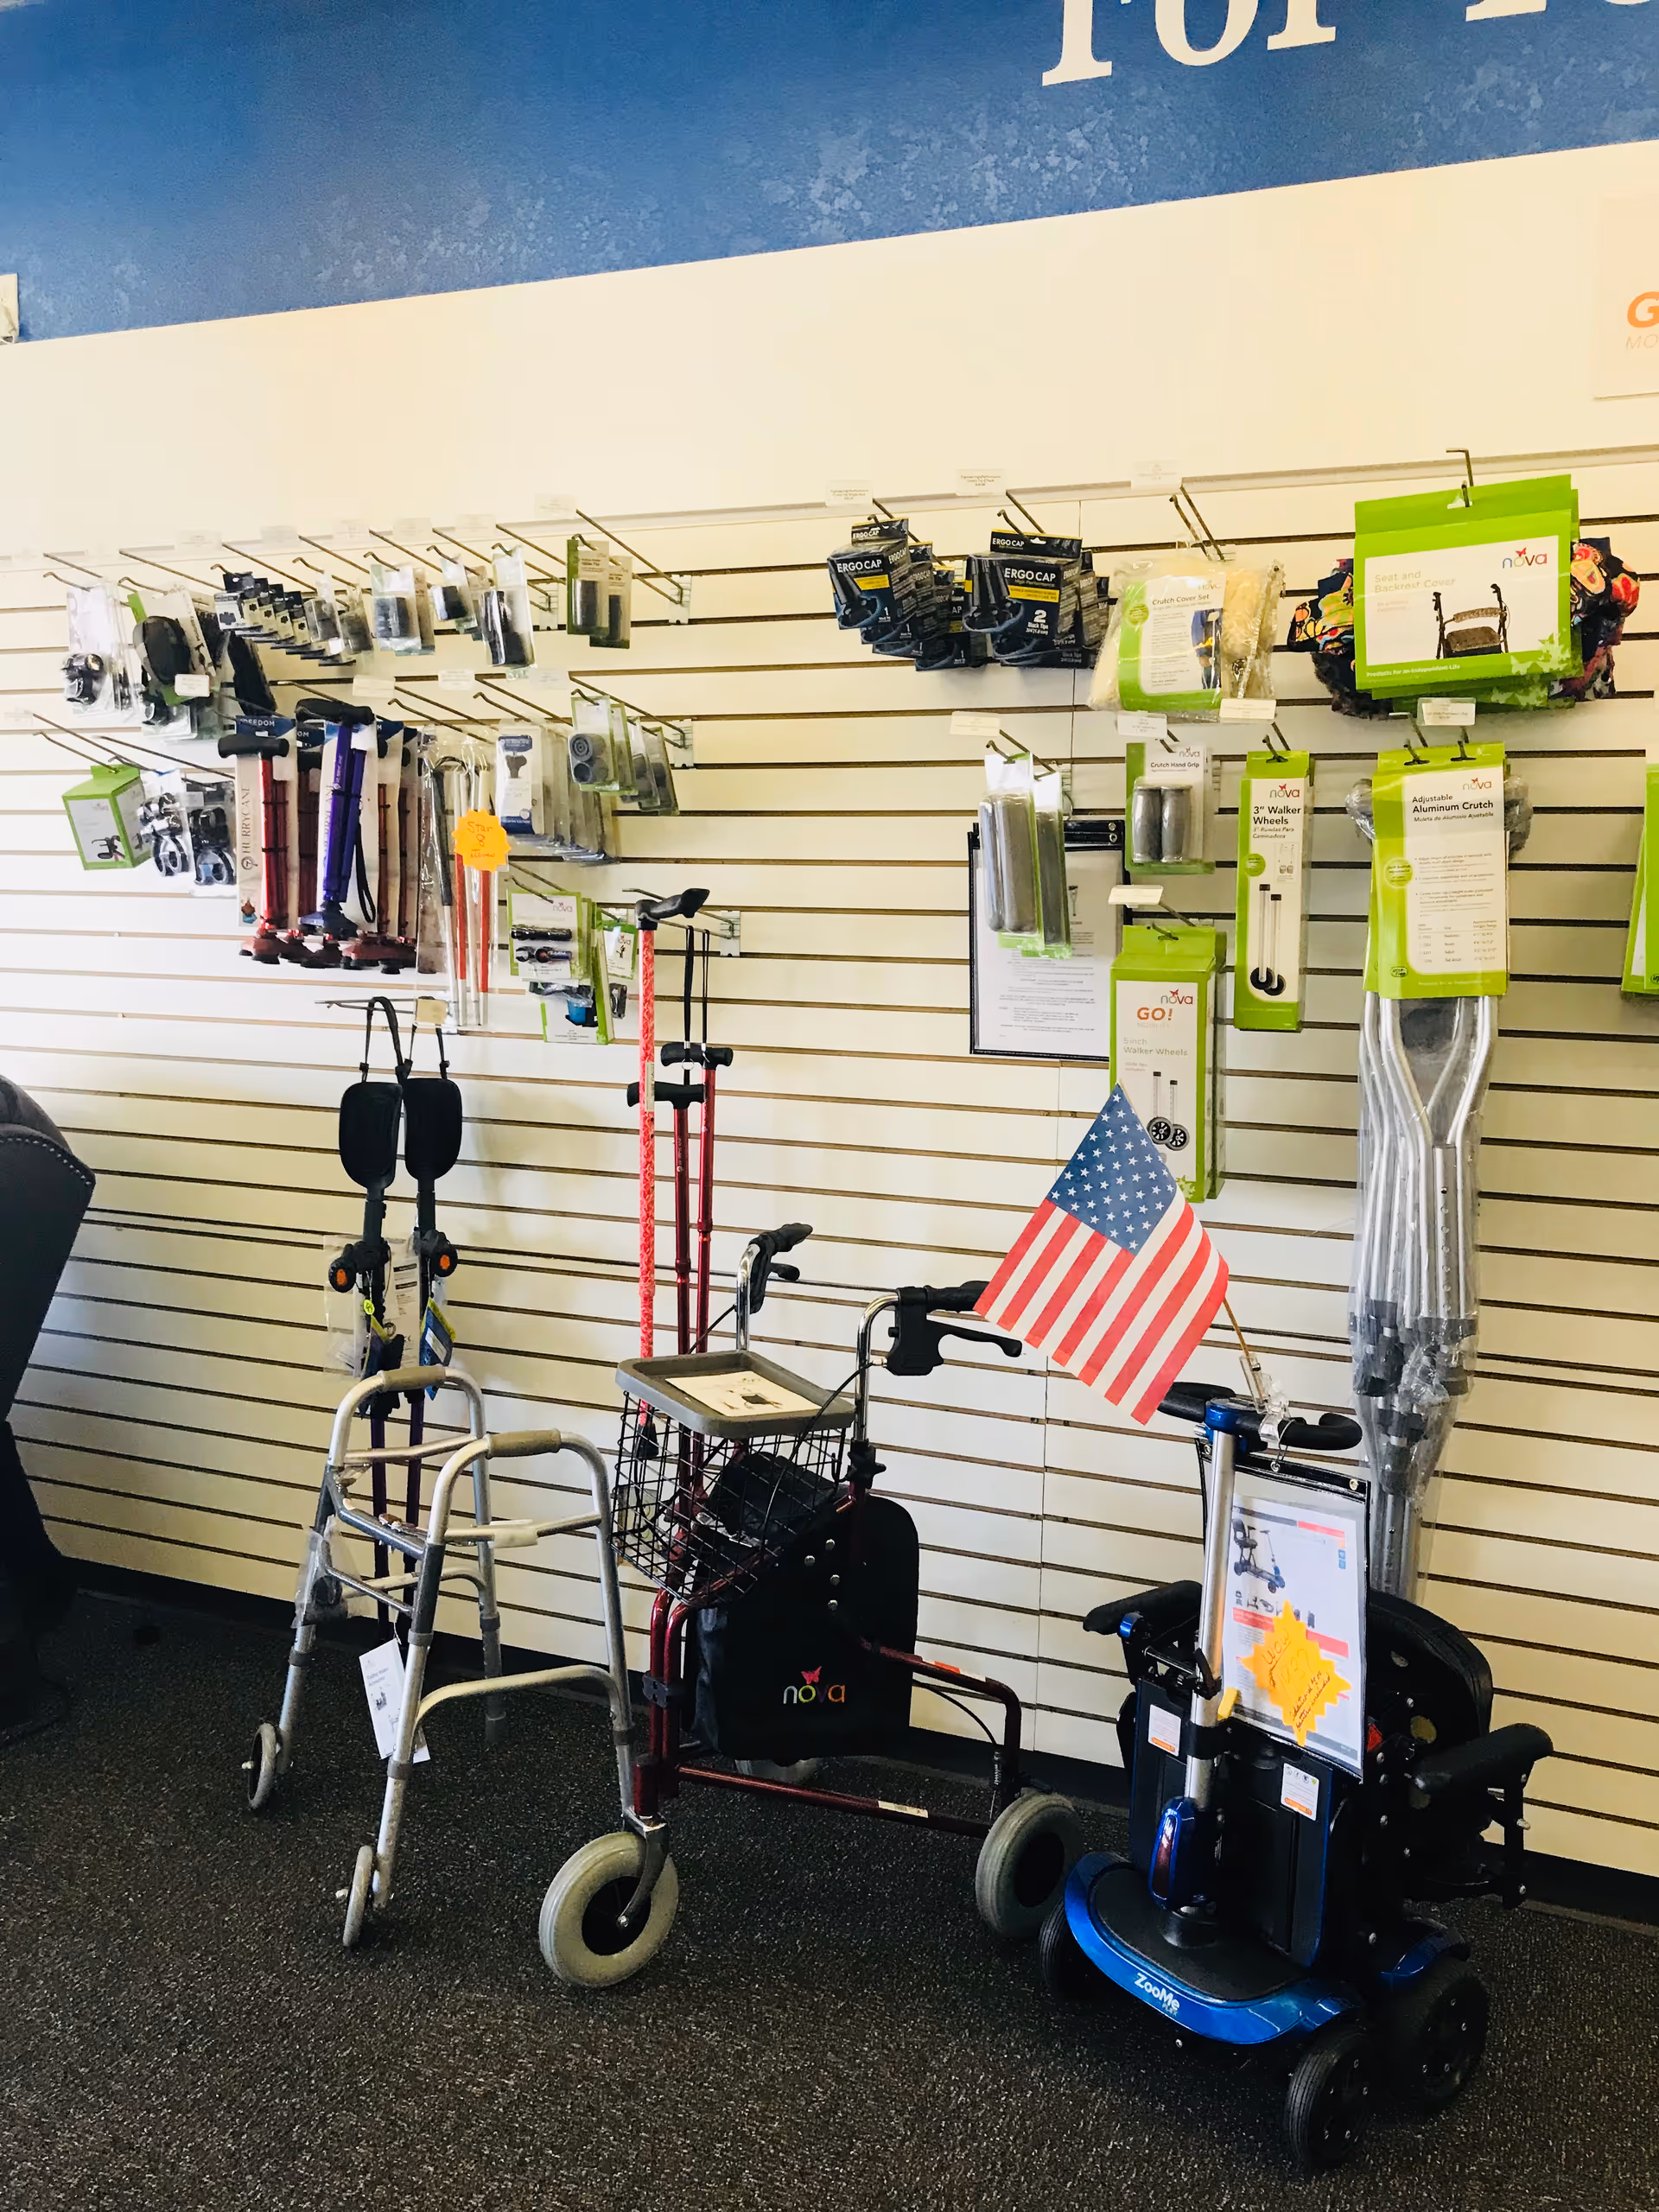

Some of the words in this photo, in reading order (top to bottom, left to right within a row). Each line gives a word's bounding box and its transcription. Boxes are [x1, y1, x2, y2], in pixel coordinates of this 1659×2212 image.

[1502, 553, 1548, 569] nova
[1375, 571, 1398, 583] Seat
[1401, 570, 1421, 581] and
[1374, 582, 1421, 594] Backrest
[1424, 577, 1456, 588] Cover
[1152, 597, 1175, 606] Crutch
[1176, 594, 1197, 603] Cover
[1033, 609, 1046, 623] 2
[1462, 780, 1492, 791] nova
[1269, 789, 1300, 798] nova
[1412, 794, 1453, 804] Adjustable
[1268, 805, 1302, 815] Walker
[1412, 804, 1459, 813] Aluminum
[1462, 800, 1494, 810] Crutch
[241, 788, 251, 854] HURRYCANE
[1253, 816, 1289, 825] Wheels
[1160, 995, 1193, 1005] nova
[1136, 1007, 1173, 1021] GO!
[783, 1684, 846, 1705] nova
[1135, 1972, 1180, 2011] ZooMe
